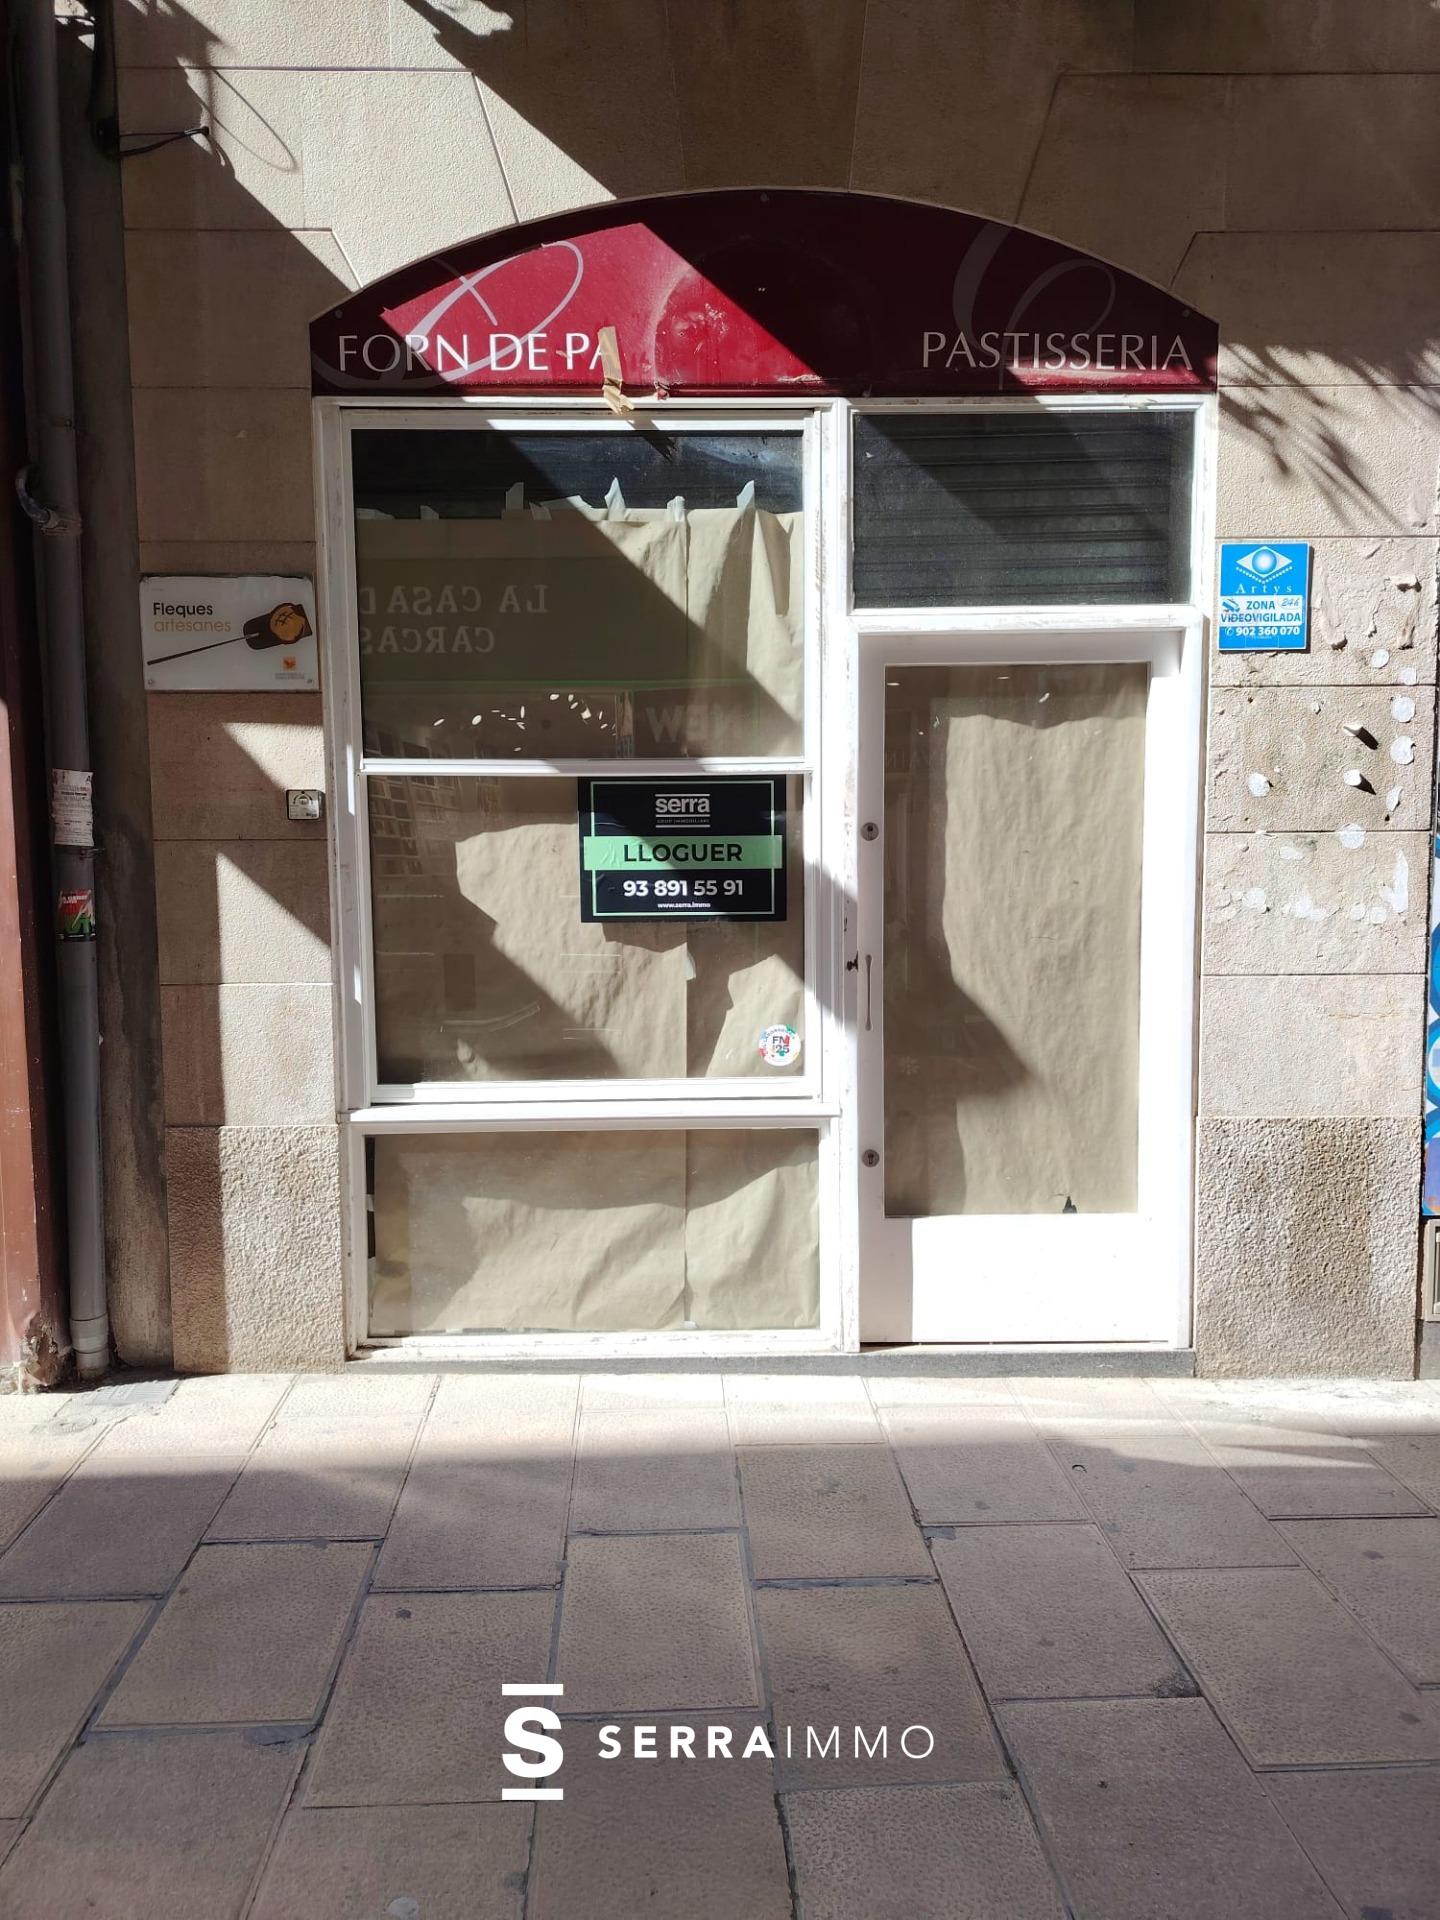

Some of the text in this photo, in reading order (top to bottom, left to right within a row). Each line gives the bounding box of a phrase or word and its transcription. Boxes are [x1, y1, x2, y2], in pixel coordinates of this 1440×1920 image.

[338, 333, 469, 372] FORN
[489, 333, 549, 371] DE
[922, 331, 1194, 371] PASTISSERIA
[1235, 583, 1293, 595] Artys
[153, 602, 213, 618] Fleques
[1246, 600, 1276, 610] ZONA
[154, 618, 231, 633] artesanes
[1220, 612, 1301, 623] VIDEOVIGILADA
[1235, 626, 1301, 636] 902 360 070
[655, 797, 711, 813] serra
[623, 843, 743, 862] LLOGUER
[623, 879, 744, 897] 93 891 55 91
